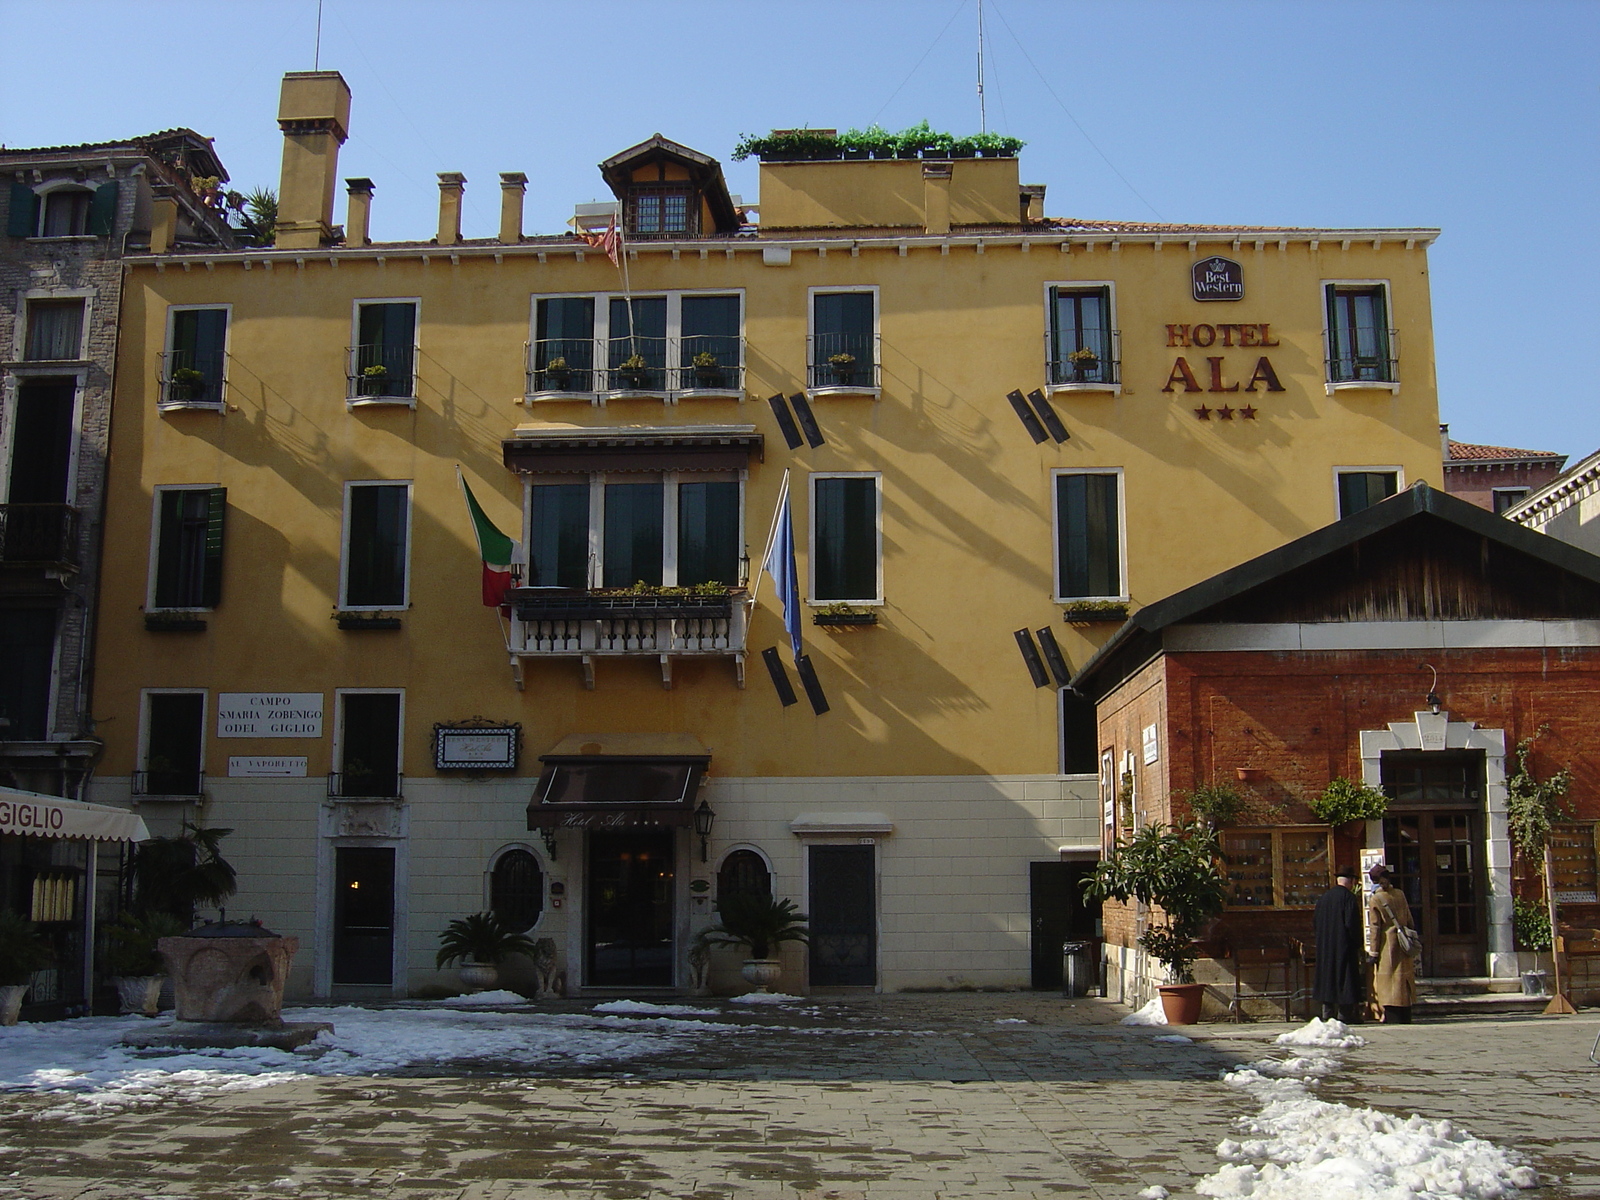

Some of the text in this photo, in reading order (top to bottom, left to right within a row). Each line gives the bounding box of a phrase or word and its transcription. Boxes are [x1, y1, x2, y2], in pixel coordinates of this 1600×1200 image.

[1205, 271, 1230, 283] Best
[1196, 281, 1242, 294] Western
[1165, 323, 1280, 348] HOTEL
[1161, 356, 1287, 393] ALA
[250, 697, 291, 706] CAMPO
[267, 710, 322, 719] ZOBENIGO
[270, 723, 315, 733] GIGLIO
[230, 760, 308, 768] AL VAPORETTO
[0, 802, 63, 830] GIGLIO
[560, 812, 626, 828] Hotel Ala
